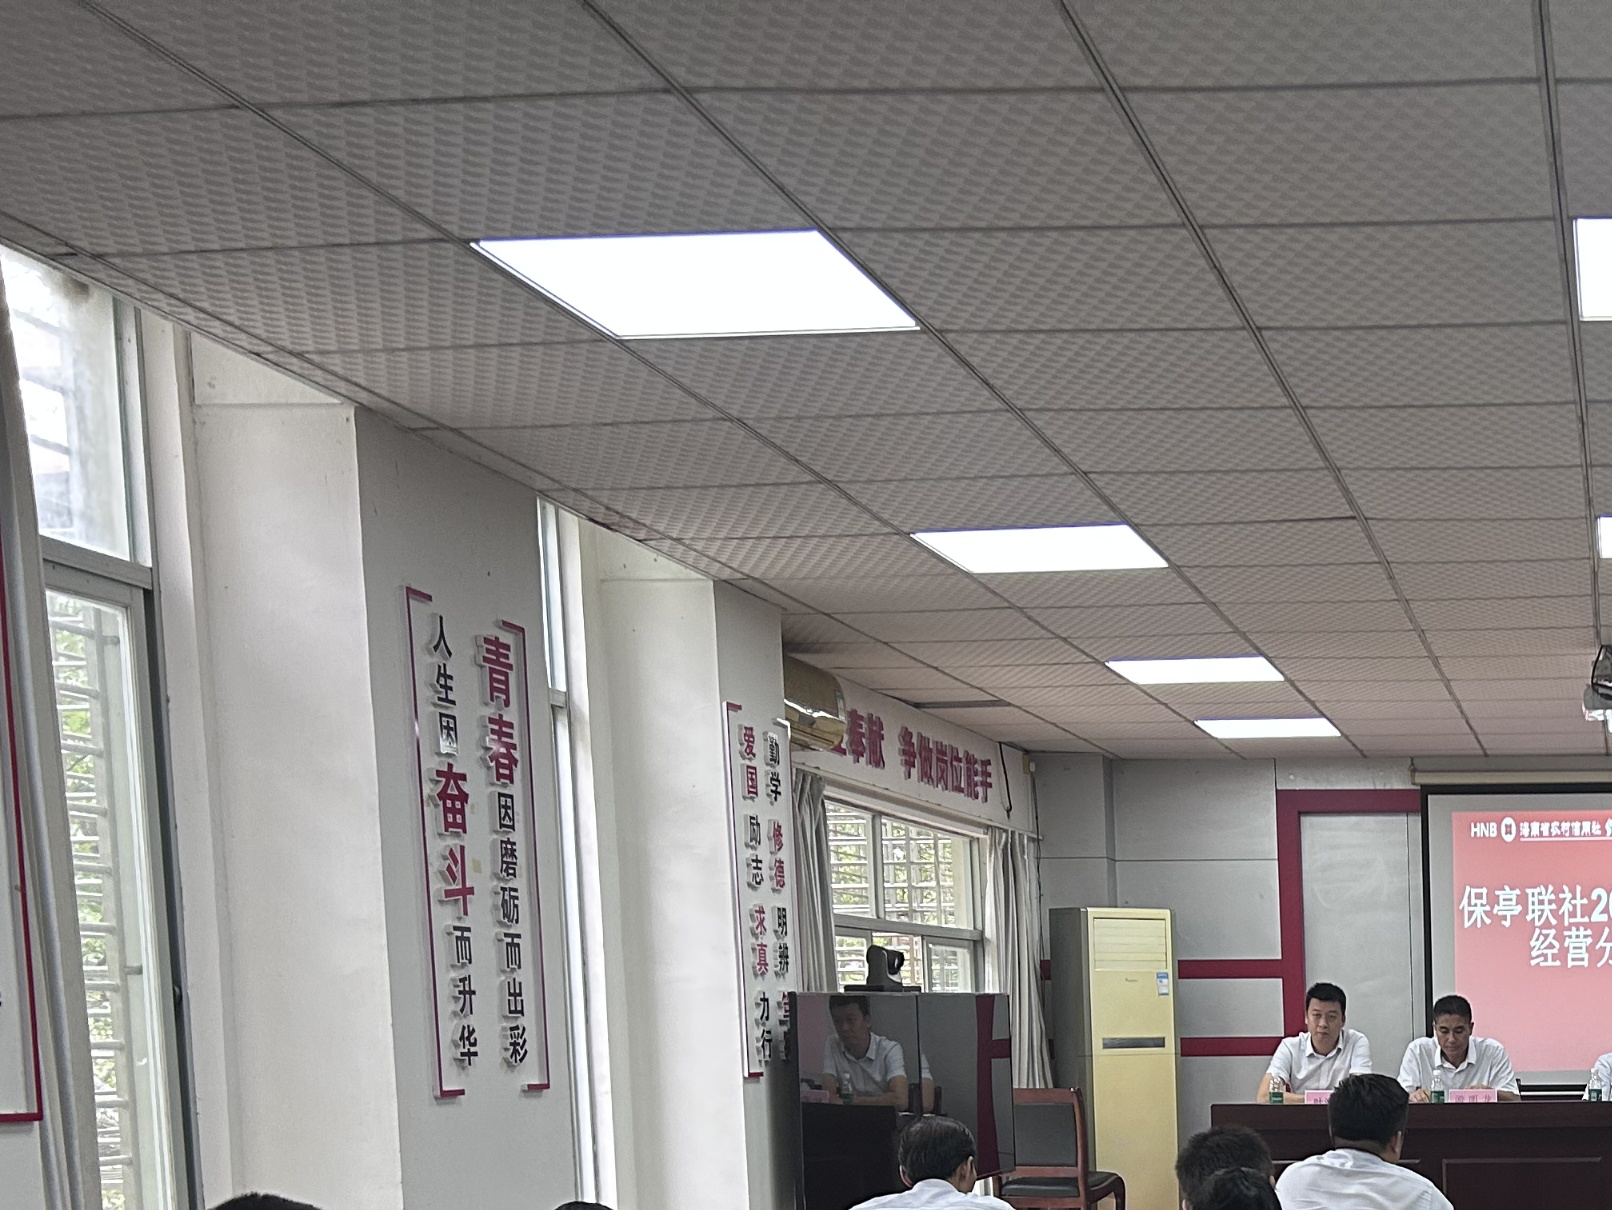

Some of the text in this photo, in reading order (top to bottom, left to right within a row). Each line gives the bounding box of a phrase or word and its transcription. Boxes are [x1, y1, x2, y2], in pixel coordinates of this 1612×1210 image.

[432, 615, 478, 1066] 人生因奋斗而升华
[482, 635, 528, 1063] 青春因磨砺而出彩
[743, 726, 773, 1059] 爱国励志求真力行
[898, 726, 992, 804] 争做岗位能手
[1470, 822, 1497, 838] HNB
